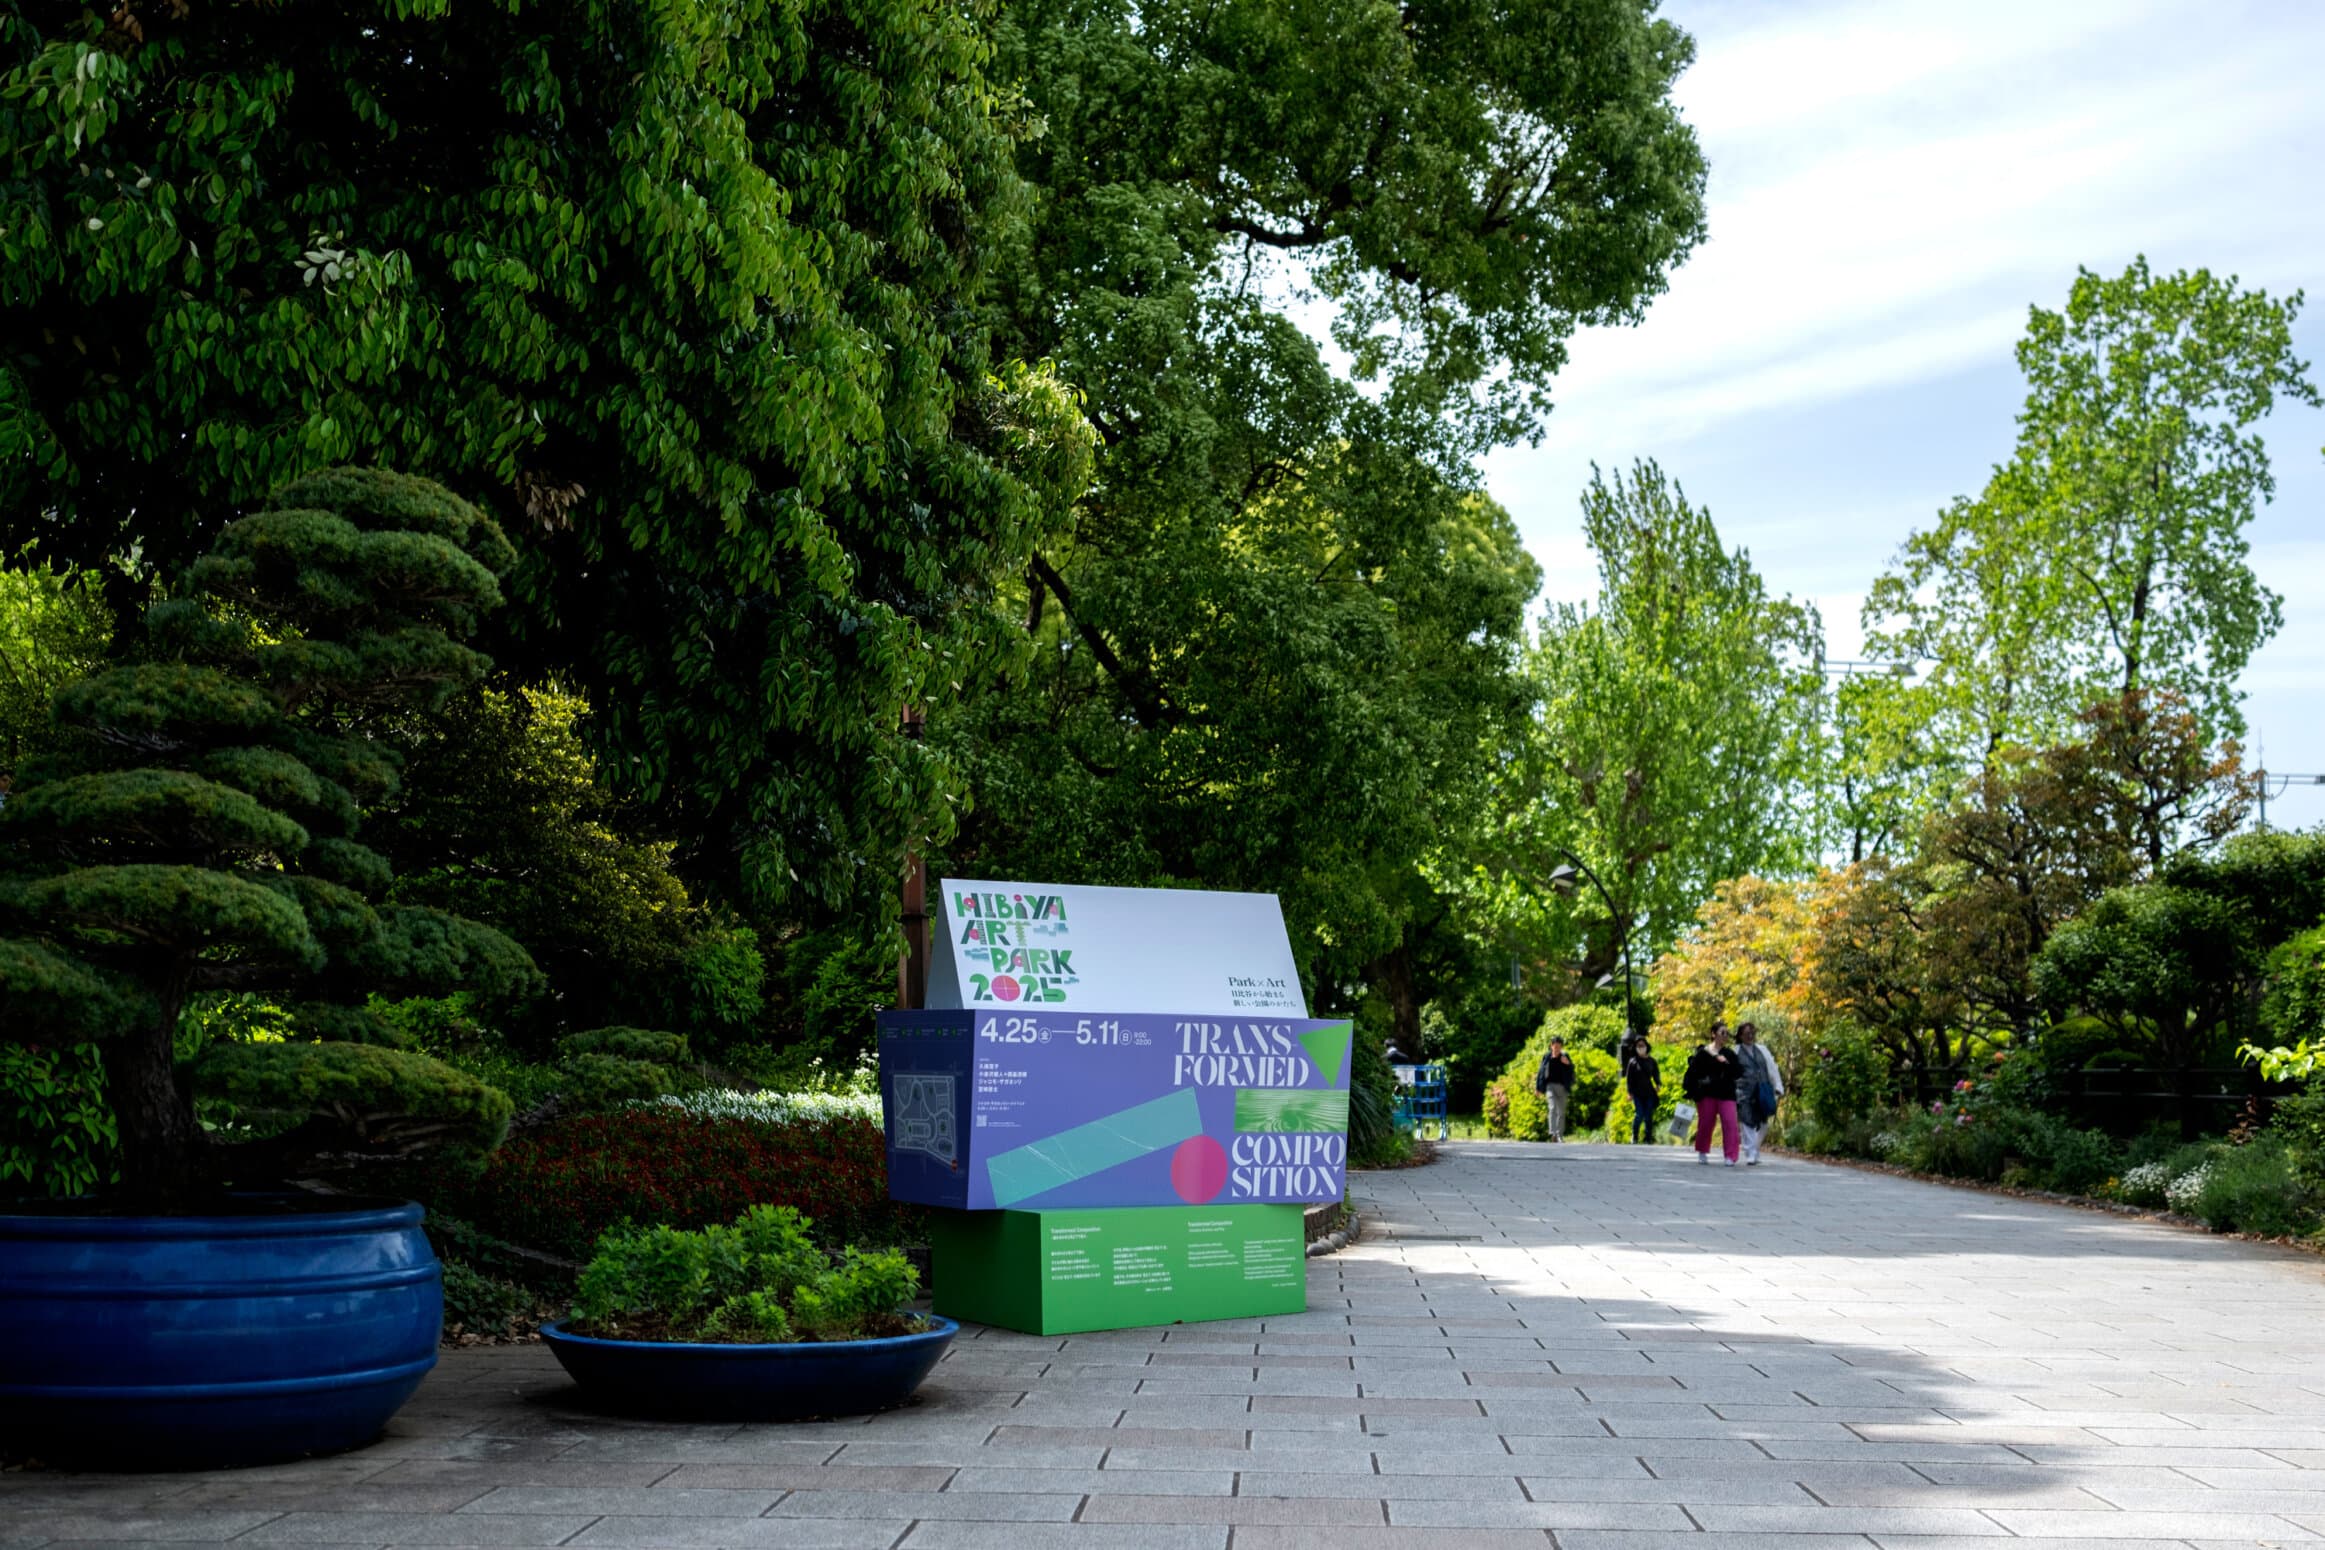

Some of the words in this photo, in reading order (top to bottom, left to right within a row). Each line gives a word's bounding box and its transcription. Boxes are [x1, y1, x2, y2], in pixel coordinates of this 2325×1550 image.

[960, 920, 1032, 946] ART
[990, 948, 1076, 974] PARK
[969, 973, 1066, 1002] 2025
[1228, 976, 1255, 987] Park
[1266, 977, 1286, 988] Art
[980, 1017, 1038, 1044] 4.25
[1076, 1019, 1119, 1045] 5.11
[1174, 1055, 1309, 1087] FORMED
[1231, 1135, 1345, 1166] COMPO
[1231, 1166, 1340, 1198] SITION
